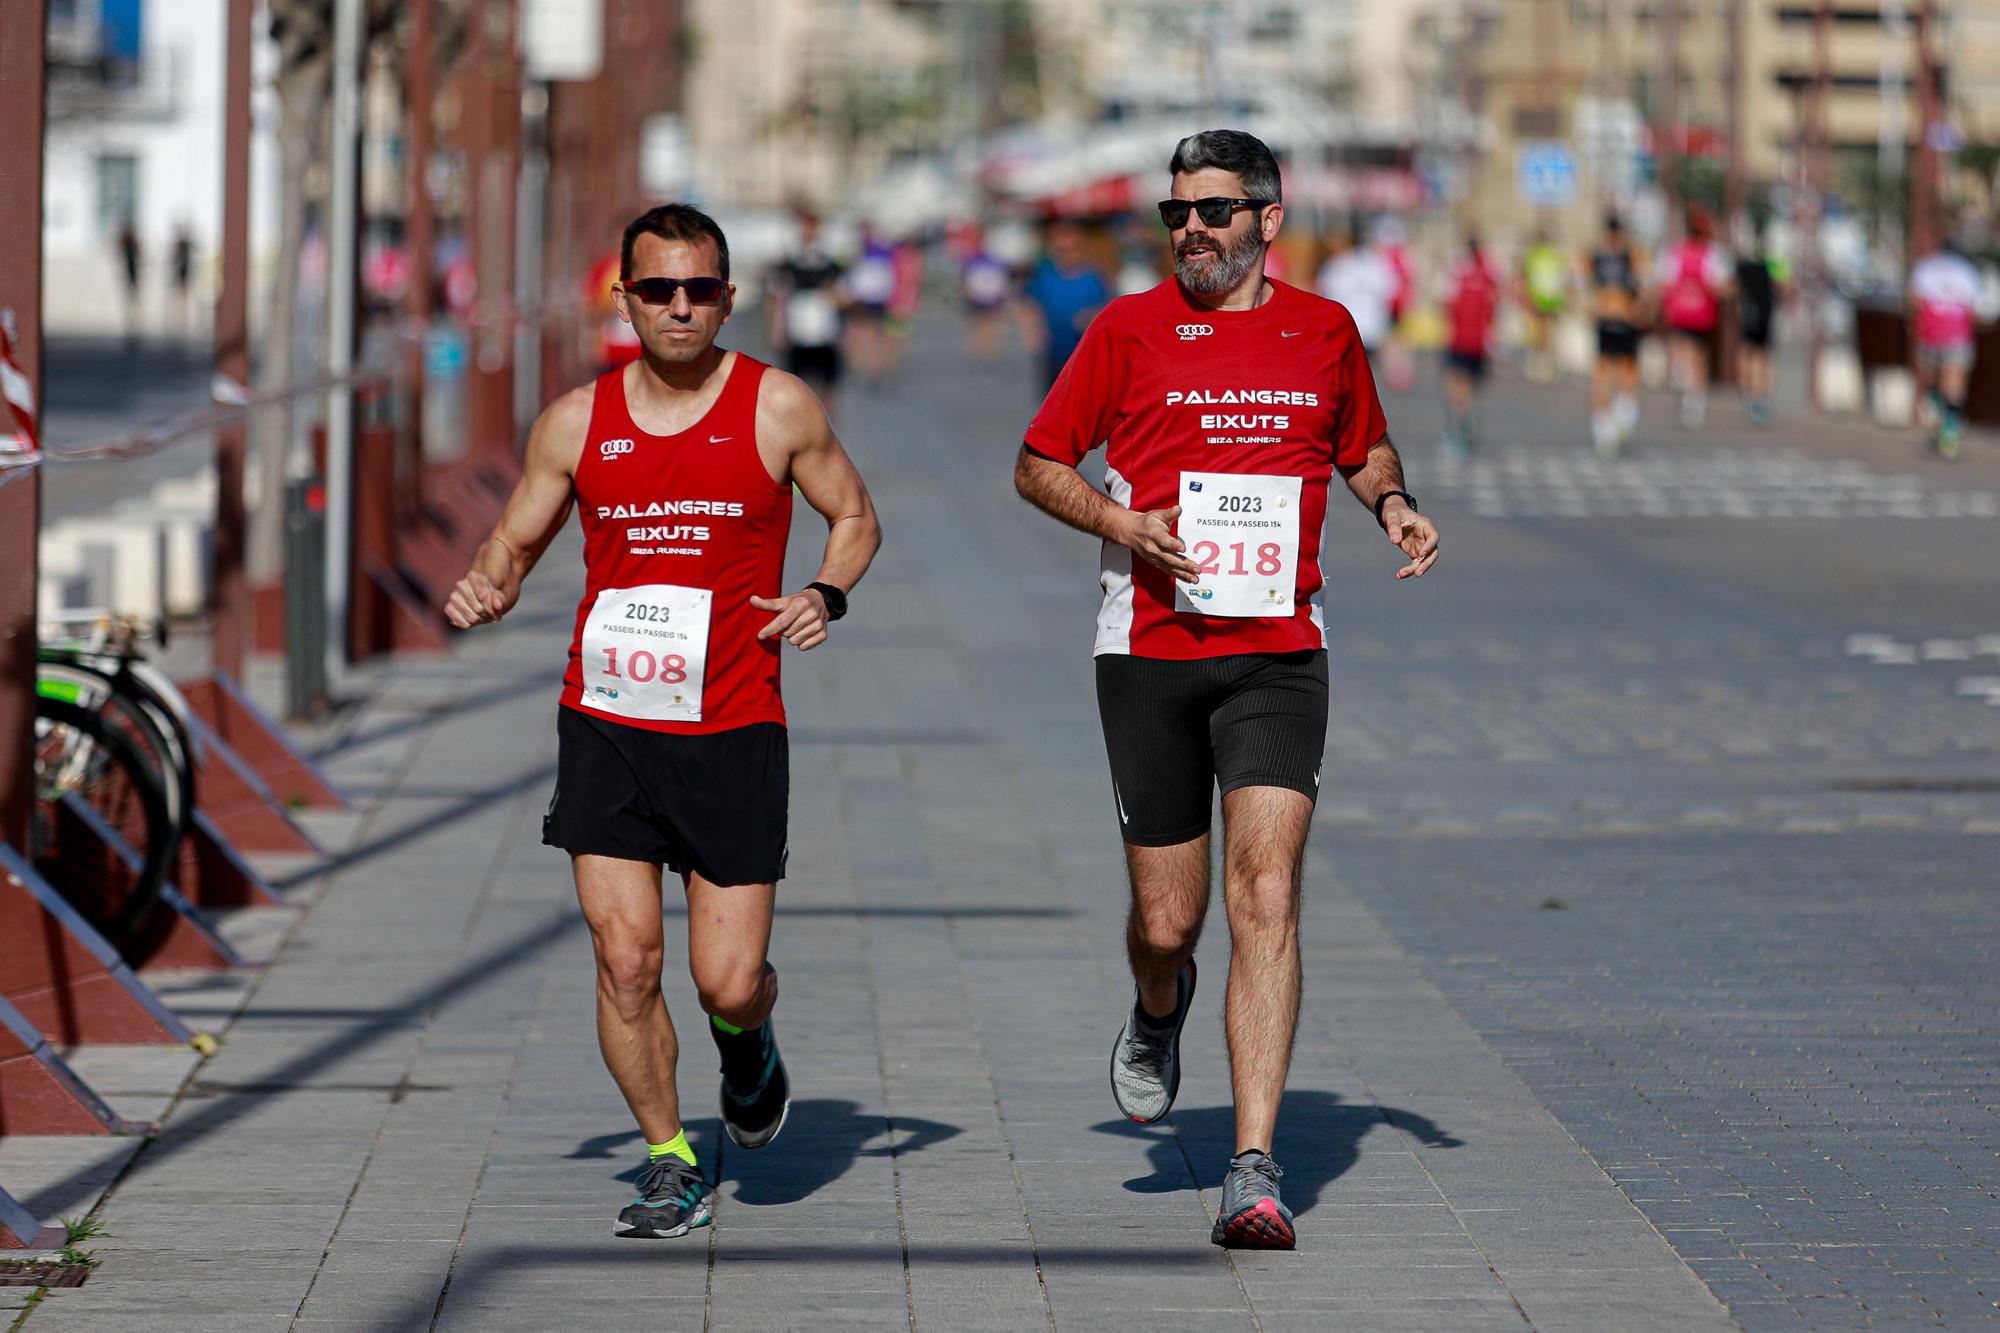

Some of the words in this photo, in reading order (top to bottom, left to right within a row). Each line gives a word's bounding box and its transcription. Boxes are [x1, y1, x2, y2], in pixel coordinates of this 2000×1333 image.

[1166, 389, 1319, 407] PALANGRES
[1200, 414, 1290, 430] EIXUTS
[1207, 436, 1234, 444] IBIZA
[1235, 436, 1282, 444] RUNNERS
[597, 500, 744, 520] PALANGRES
[1218, 495, 1263, 513] 2023
[1196, 518, 1229, 527] PASSEIG
[1237, 520, 1269, 528] PASSEIG
[626, 525, 711, 541] EIXUTS
[630, 547, 655, 555] IBIZA
[656, 547, 703, 556] RUNNERS
[1192, 540, 1282, 577] 218
[625, 603, 670, 623] 2023
[602, 624, 635, 634] PASSEIG
[643, 628, 675, 639] PASSEIG
[602, 647, 687, 685] 108
